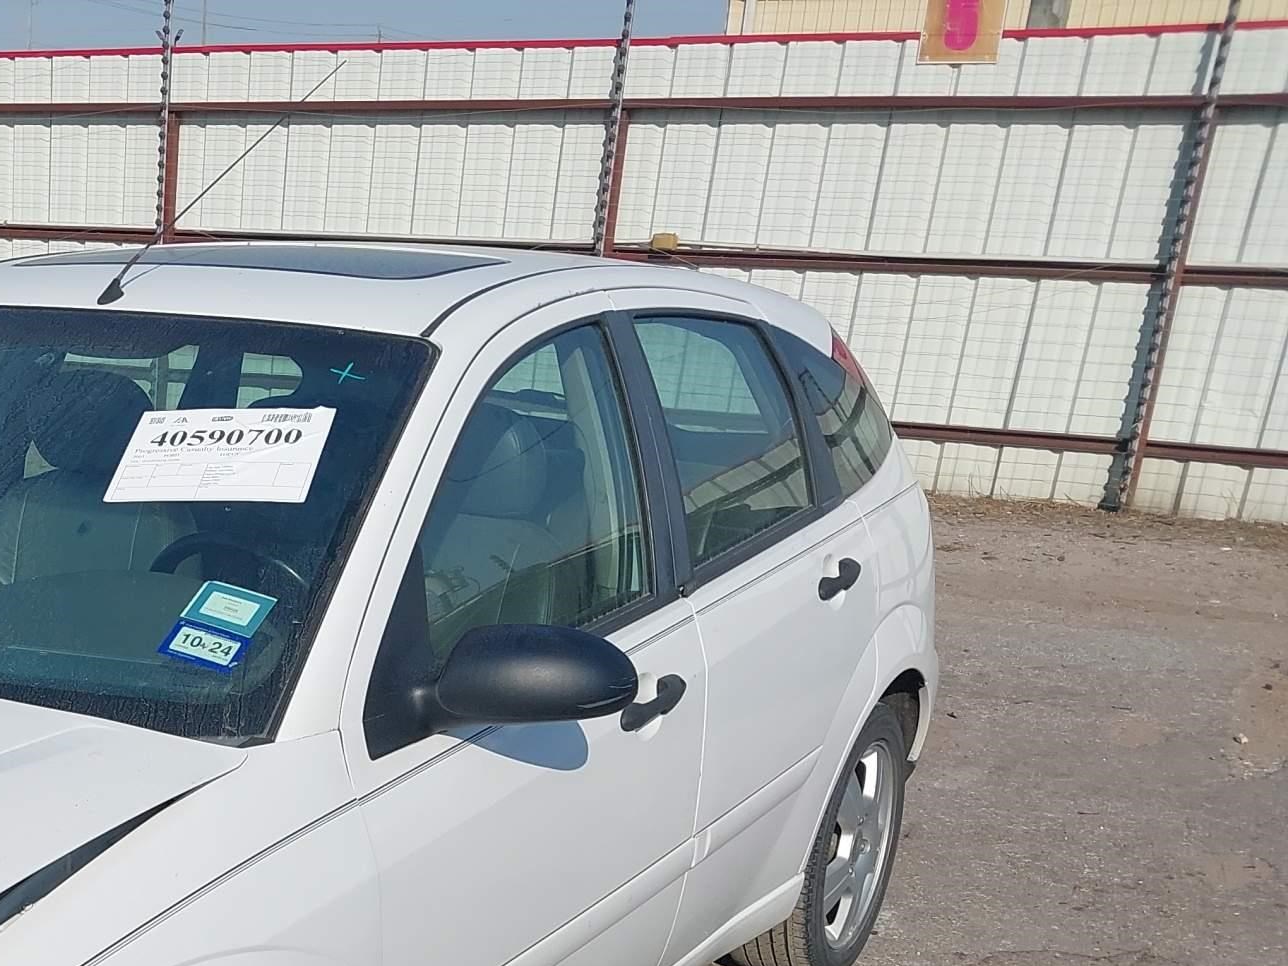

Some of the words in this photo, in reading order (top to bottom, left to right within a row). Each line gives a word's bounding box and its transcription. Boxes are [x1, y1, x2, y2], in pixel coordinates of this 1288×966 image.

[150, 428, 303, 447] 40590700
[181, 633, 202, 648] 10
[208, 641, 233, 657] 24
